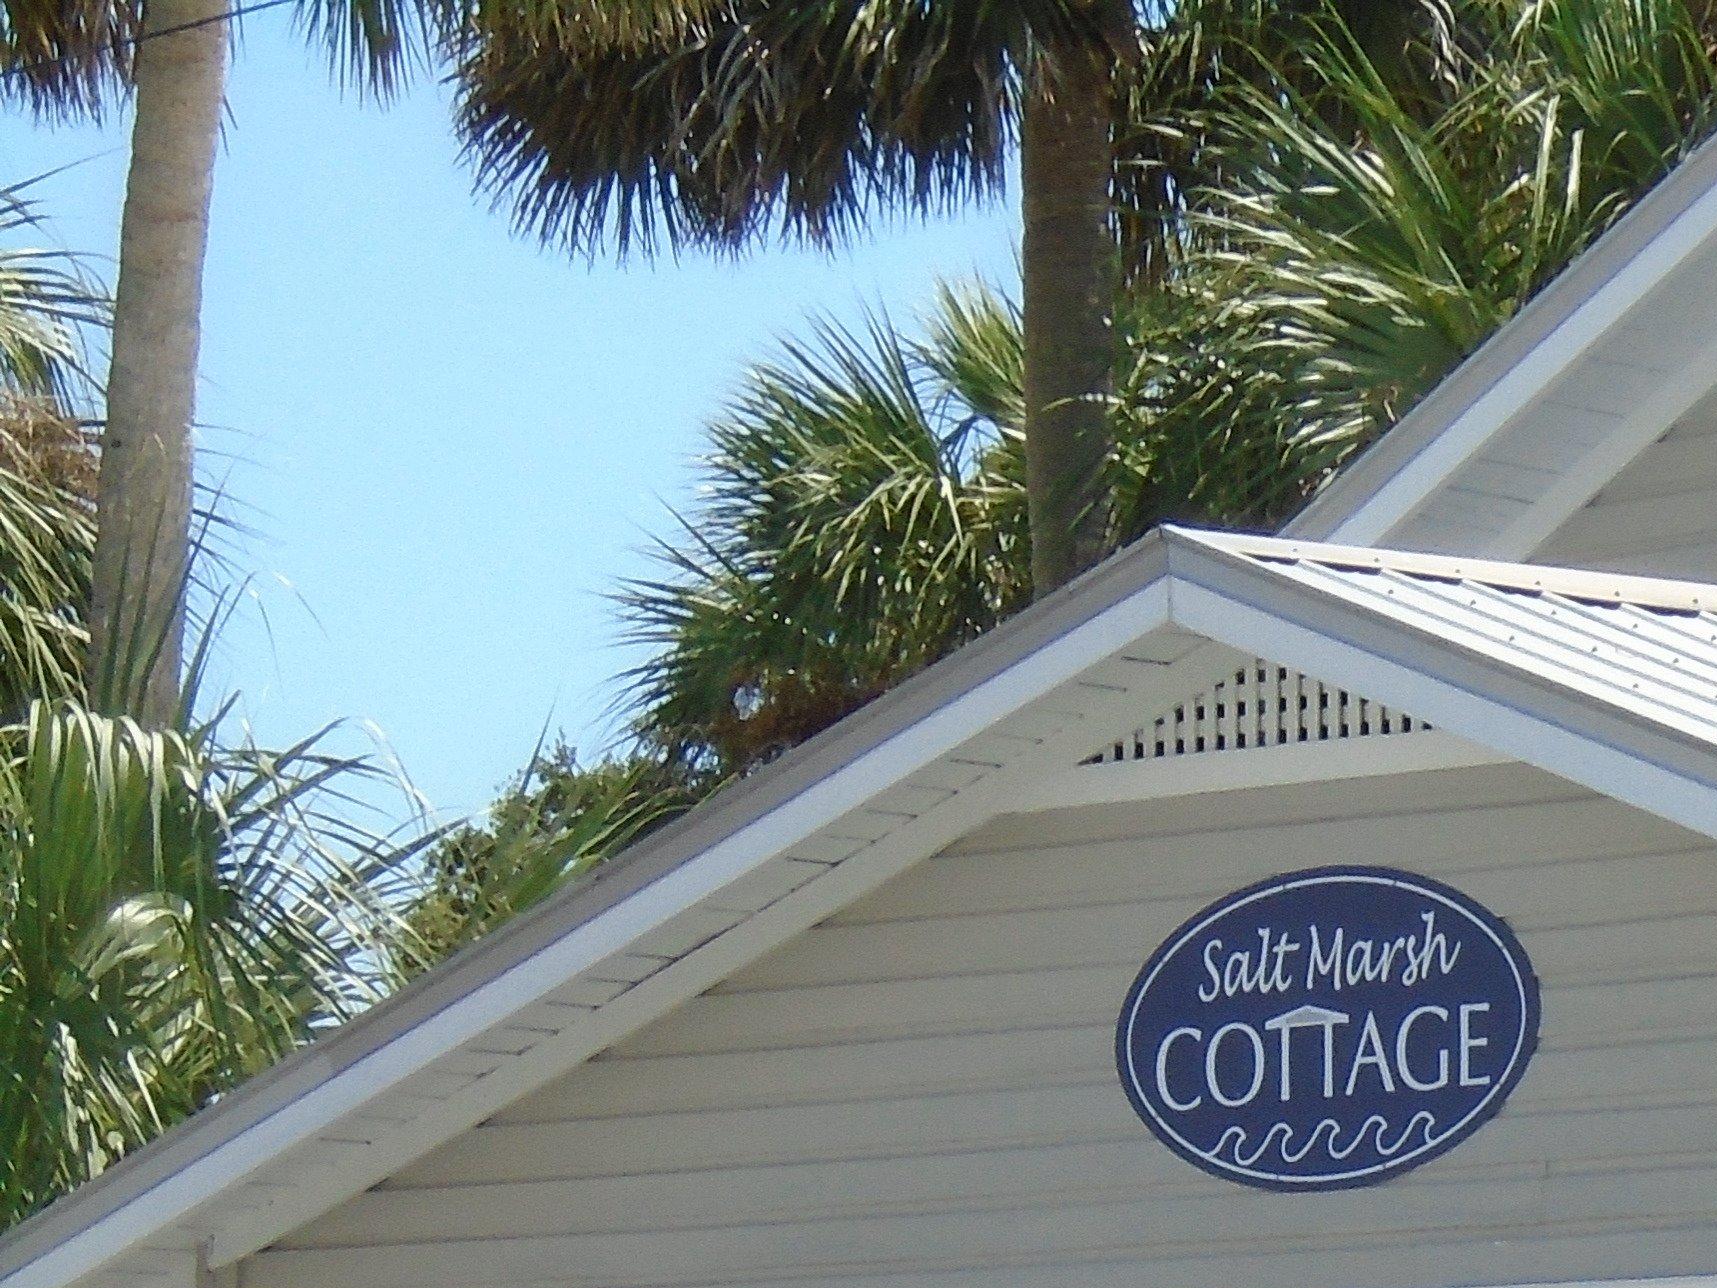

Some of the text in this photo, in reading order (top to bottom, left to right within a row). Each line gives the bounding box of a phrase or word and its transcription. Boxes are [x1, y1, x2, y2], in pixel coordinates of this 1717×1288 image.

[1198, 911, 1461, 1003] Salt Marsh
[1155, 1002, 1491, 1111] COTTAGE
